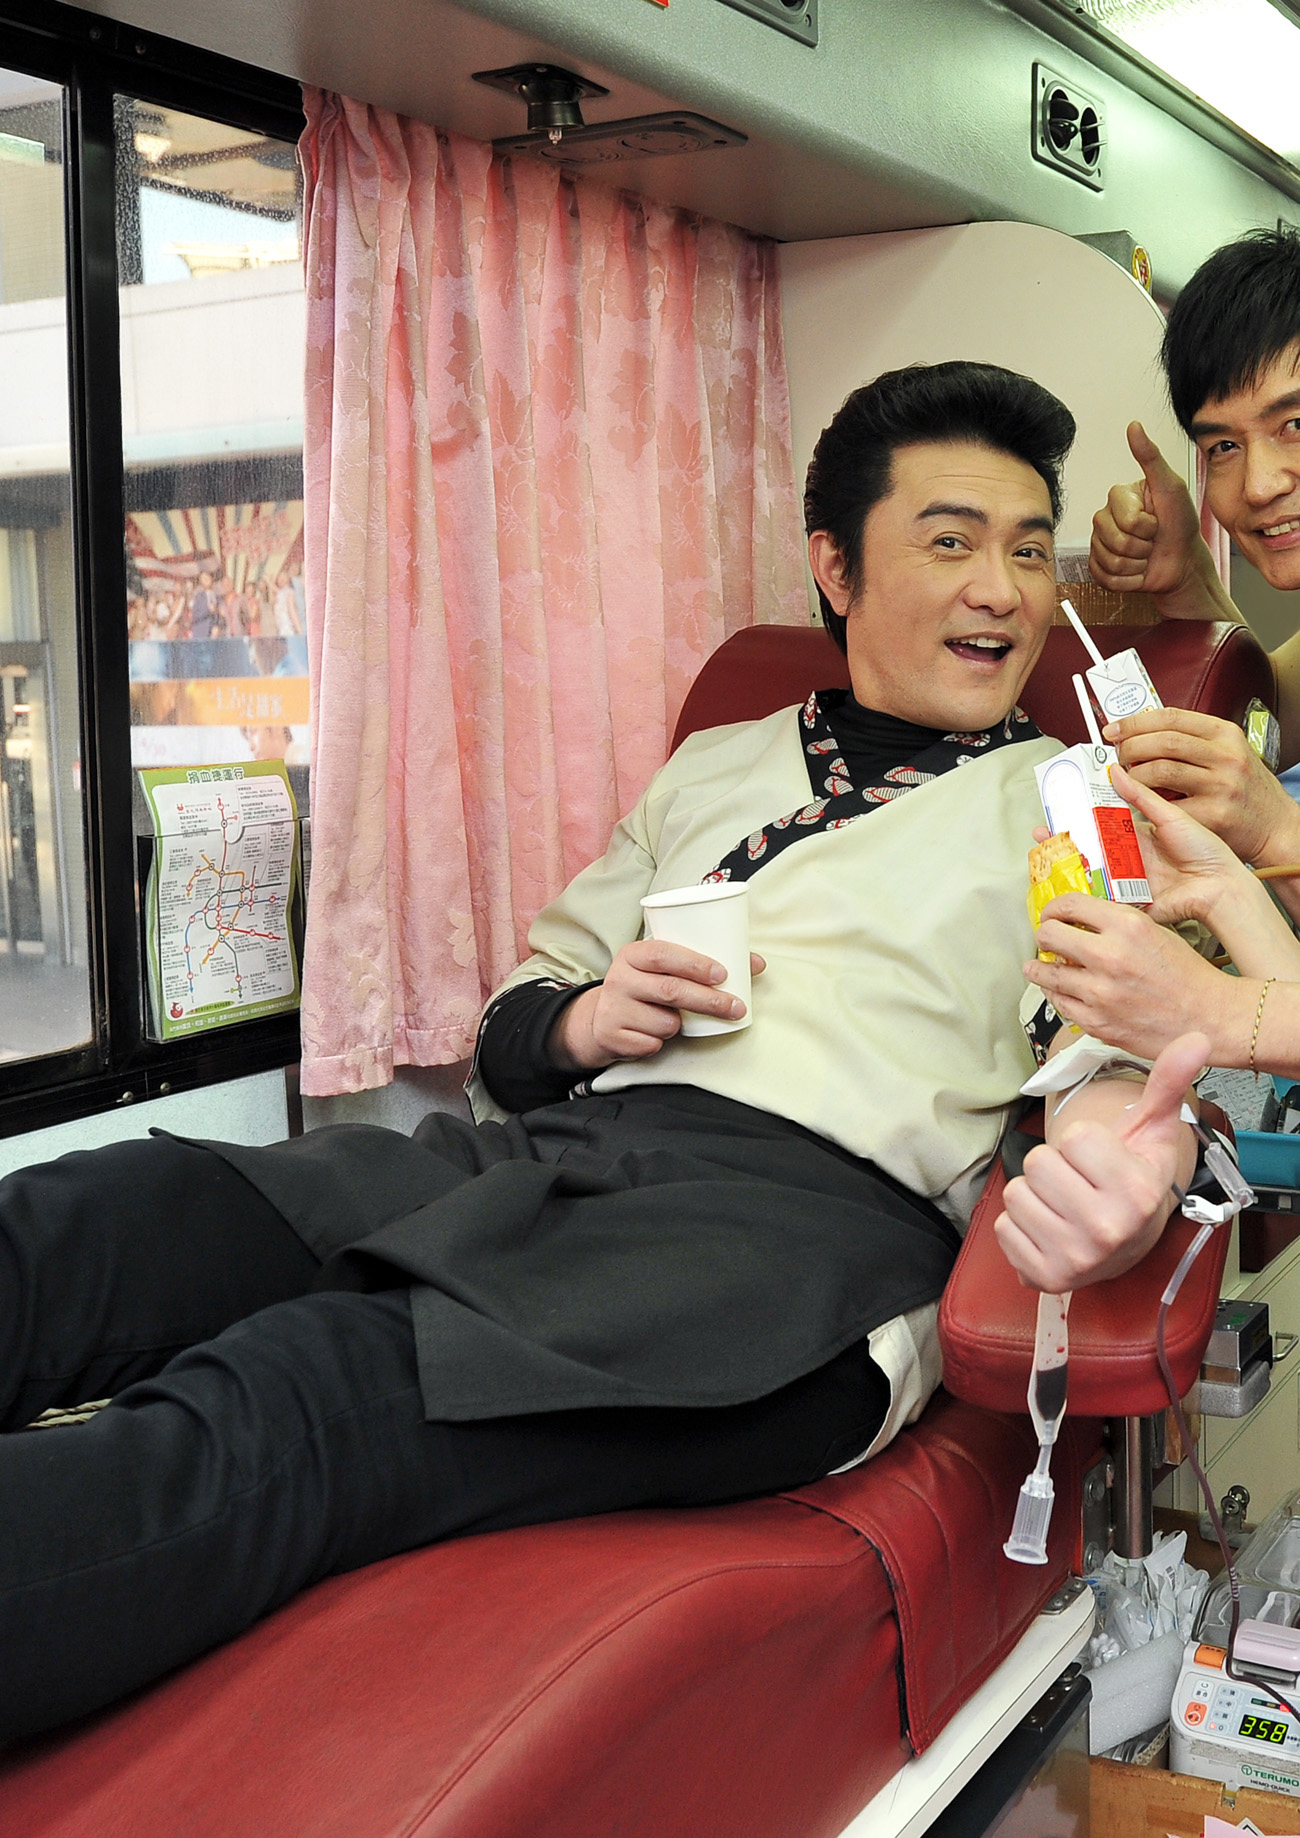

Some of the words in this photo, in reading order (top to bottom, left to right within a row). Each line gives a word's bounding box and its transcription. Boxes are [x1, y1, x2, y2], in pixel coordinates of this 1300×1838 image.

[187, 767, 244, 784] 捐血捷運行
[1240, 1716, 1287, 1742] 358
[1250, 1779, 1291, 1793] HEMO-QUICK
[1253, 1769, 1300, 1787] TERUMO
